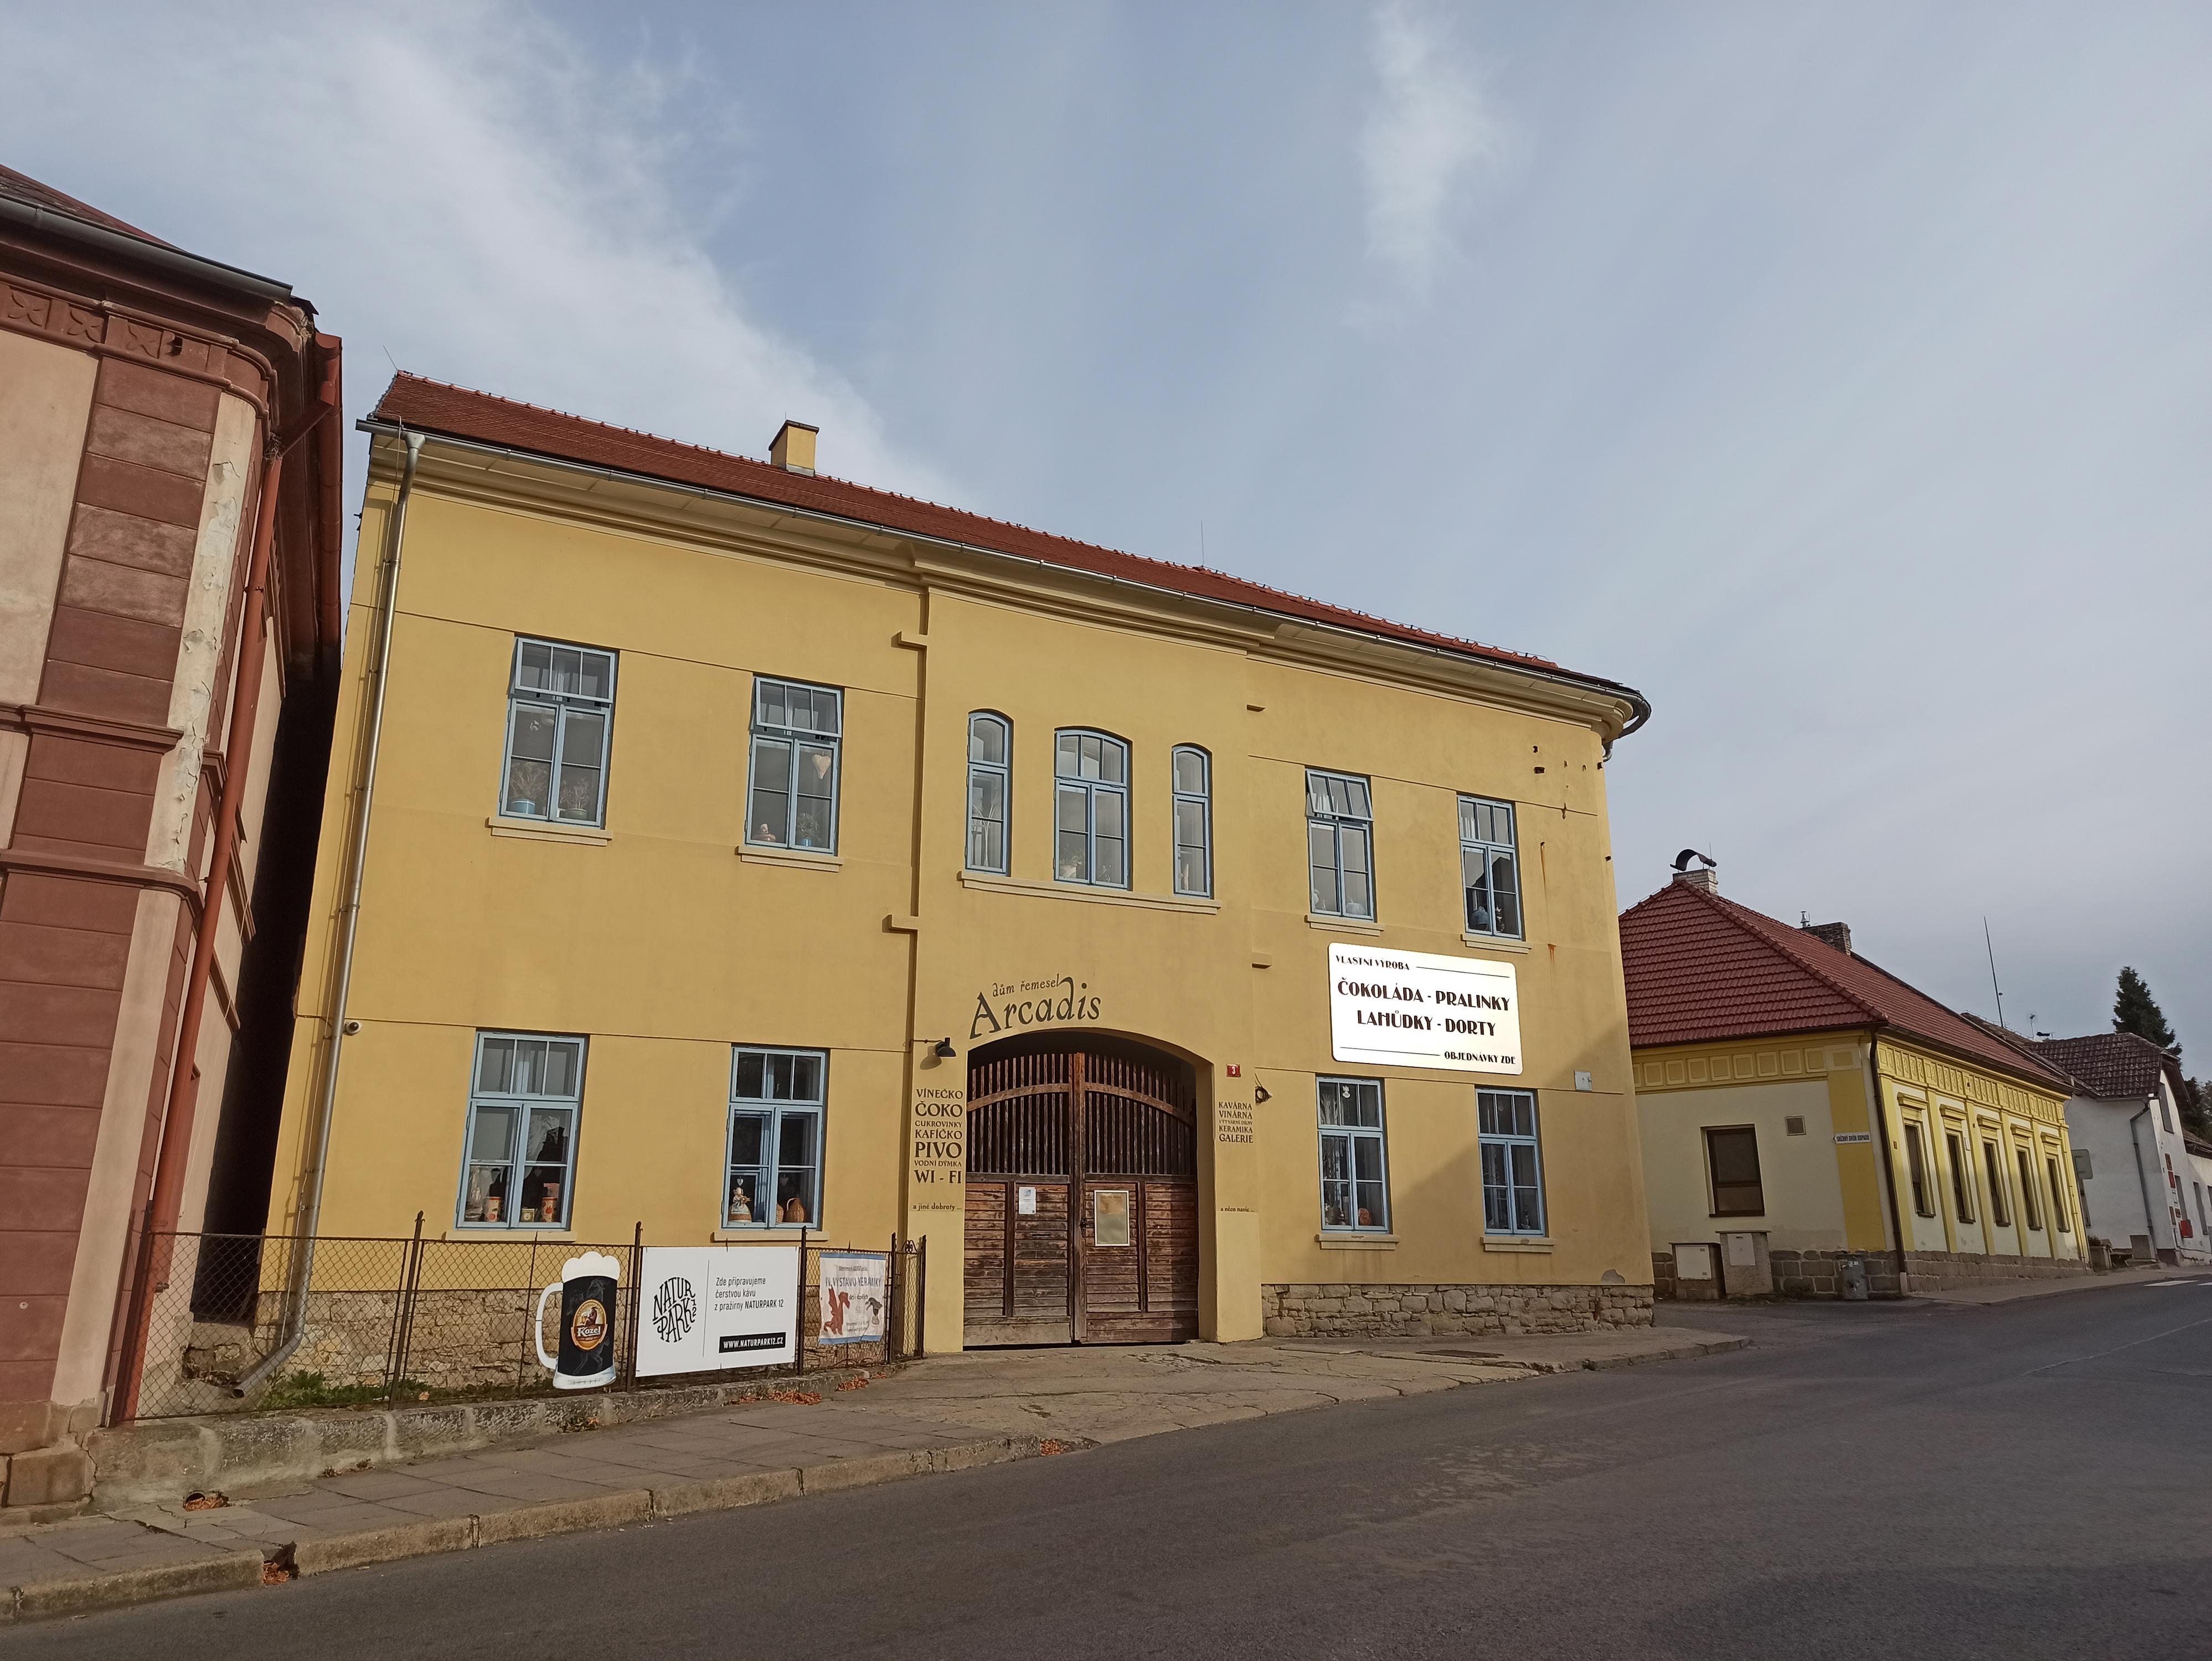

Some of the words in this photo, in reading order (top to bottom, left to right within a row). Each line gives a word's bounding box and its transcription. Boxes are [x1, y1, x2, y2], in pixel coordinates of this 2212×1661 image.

[1336, 955, 1373, 967] VLASTNÍ
[1375, 958, 1410, 971] VÝROBA
[992, 983, 1015, 997] dům
[1020, 973, 1060, 992] řemesel
[1337, 977, 1424, 1003] ČOKOLÁDA
[1435, 991, 1510, 1011] PRALINKY
[969, 976, 1101, 1040] Arcadis
[1357, 1010, 1433, 1031] LAHŮDKY
[1445, 1018, 1496, 1036] DORTY
[1444, 1051, 1498, 1064] OBJEDNÁVKY
[1501, 1055, 1516, 1065] ZDE
[1231, 1066, 1236, 1075] 3
[916, 1087, 963, 1100] VÍNEČKO
[915, 1101, 963, 1117] ČOKO
[1218, 1101, 1252, 1110] KAVÁRNA
[1219, 1109, 1253, 1120] VINÁRNA
[915, 1128, 962, 1139] KAFÍČKO
[1219, 1124, 1253, 1133] KERAMIKA
[1219, 1133, 1254, 1143] GALERIE
[914, 1142, 962, 1159] PIVO
[914, 1169, 935, 1183] WI
[949, 1170, 962, 1184] FI
[931, 1202, 955, 1211] dobroty
[716, 1277, 726, 1286] Zde
[728, 1276, 766, 1287] připravujeme
[653, 1277, 696, 1322] NATUR
[715, 1289, 741, 1298] čerstvou
[743, 1288, 756, 1297] kávu
[719, 1301, 743, 1312] pražírny
[745, 1299, 777, 1309] NATURPARK
[778, 1299, 784, 1308] 12
[577, 1327, 601, 1337] Kozel
[723, 1337, 783, 1349] WWW.NATURPARK12.CZ
